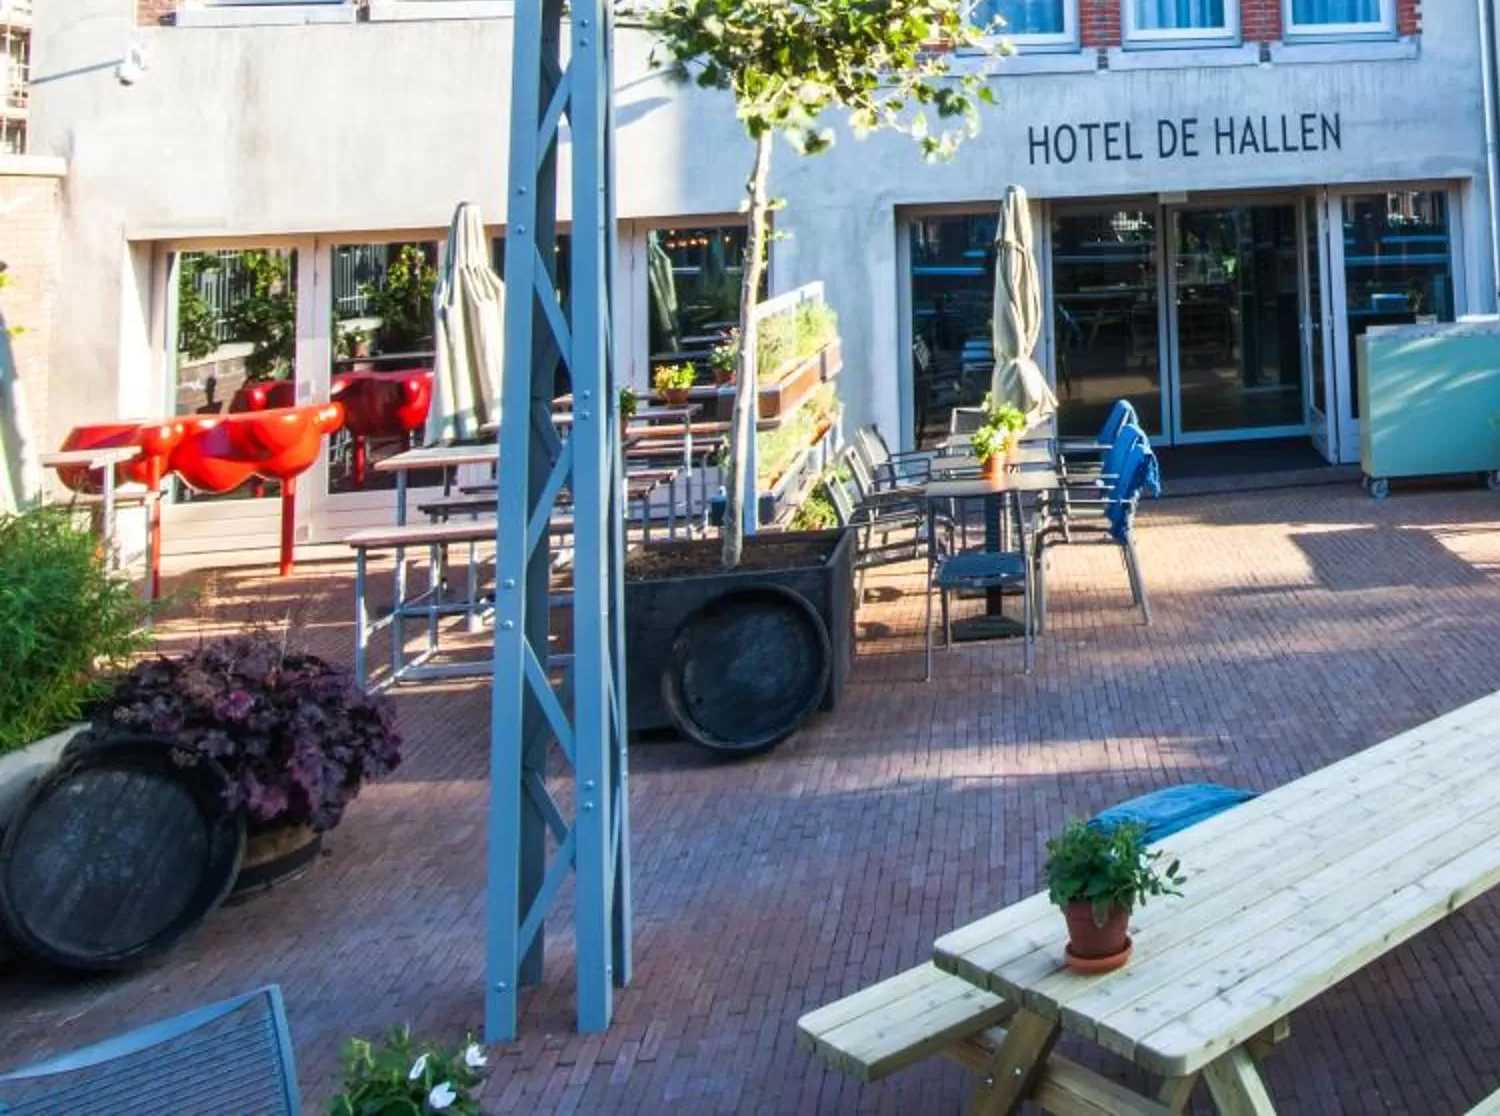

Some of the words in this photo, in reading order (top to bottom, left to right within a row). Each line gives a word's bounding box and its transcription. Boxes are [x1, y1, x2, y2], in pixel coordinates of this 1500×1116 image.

[1028, 122, 1143, 165] HOTEL
[1157, 118, 1200, 159] DE
[1214, 113, 1343, 155] HALLEN
